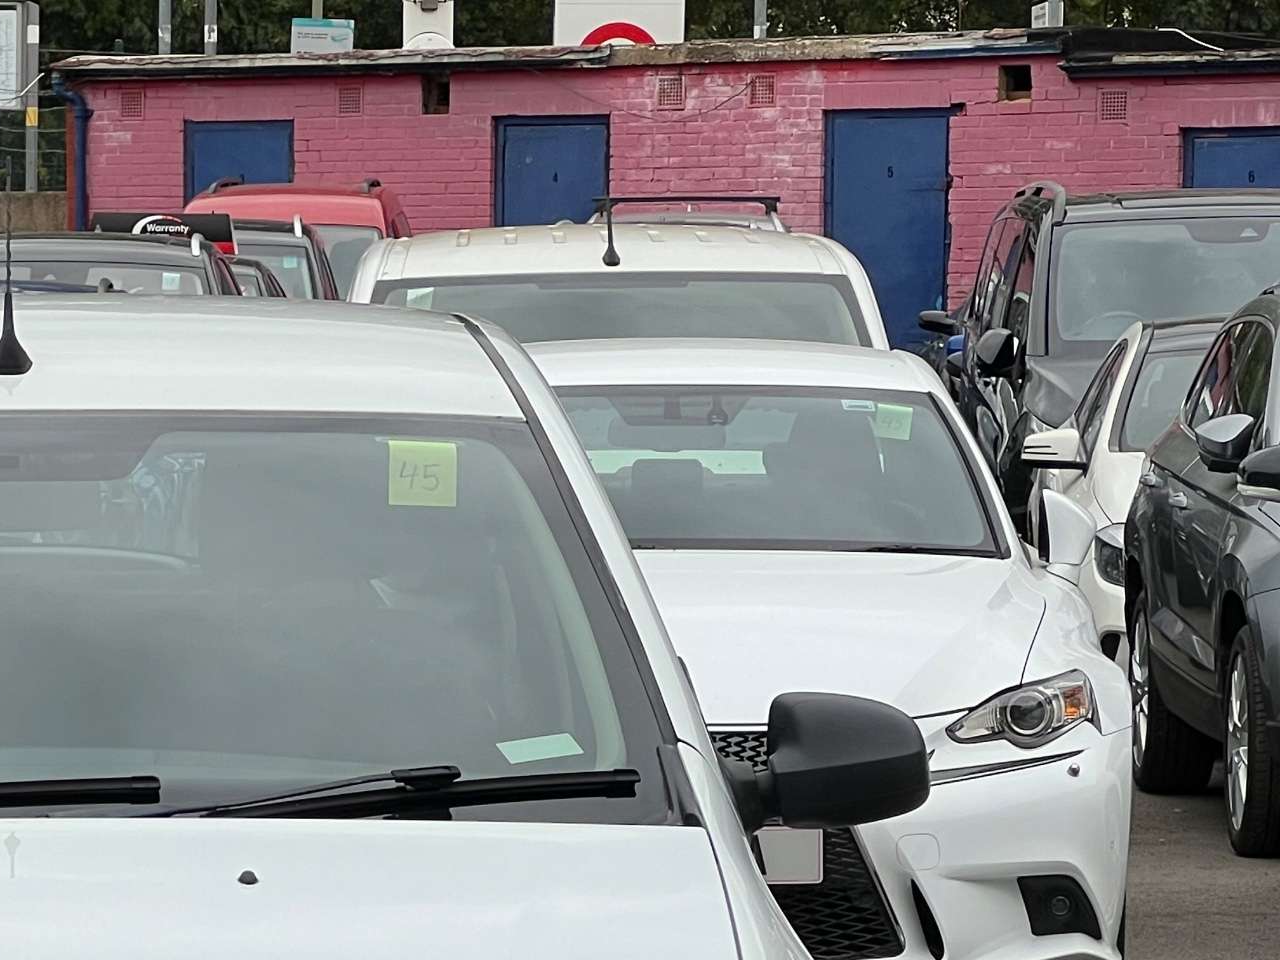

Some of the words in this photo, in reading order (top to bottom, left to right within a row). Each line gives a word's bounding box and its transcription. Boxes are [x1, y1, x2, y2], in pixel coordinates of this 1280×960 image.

[887, 166, 894, 178] 5
[1248, 170, 1256, 183] 6
[146, 223, 189, 234] Warranty
[400, 461, 440, 492] 45
